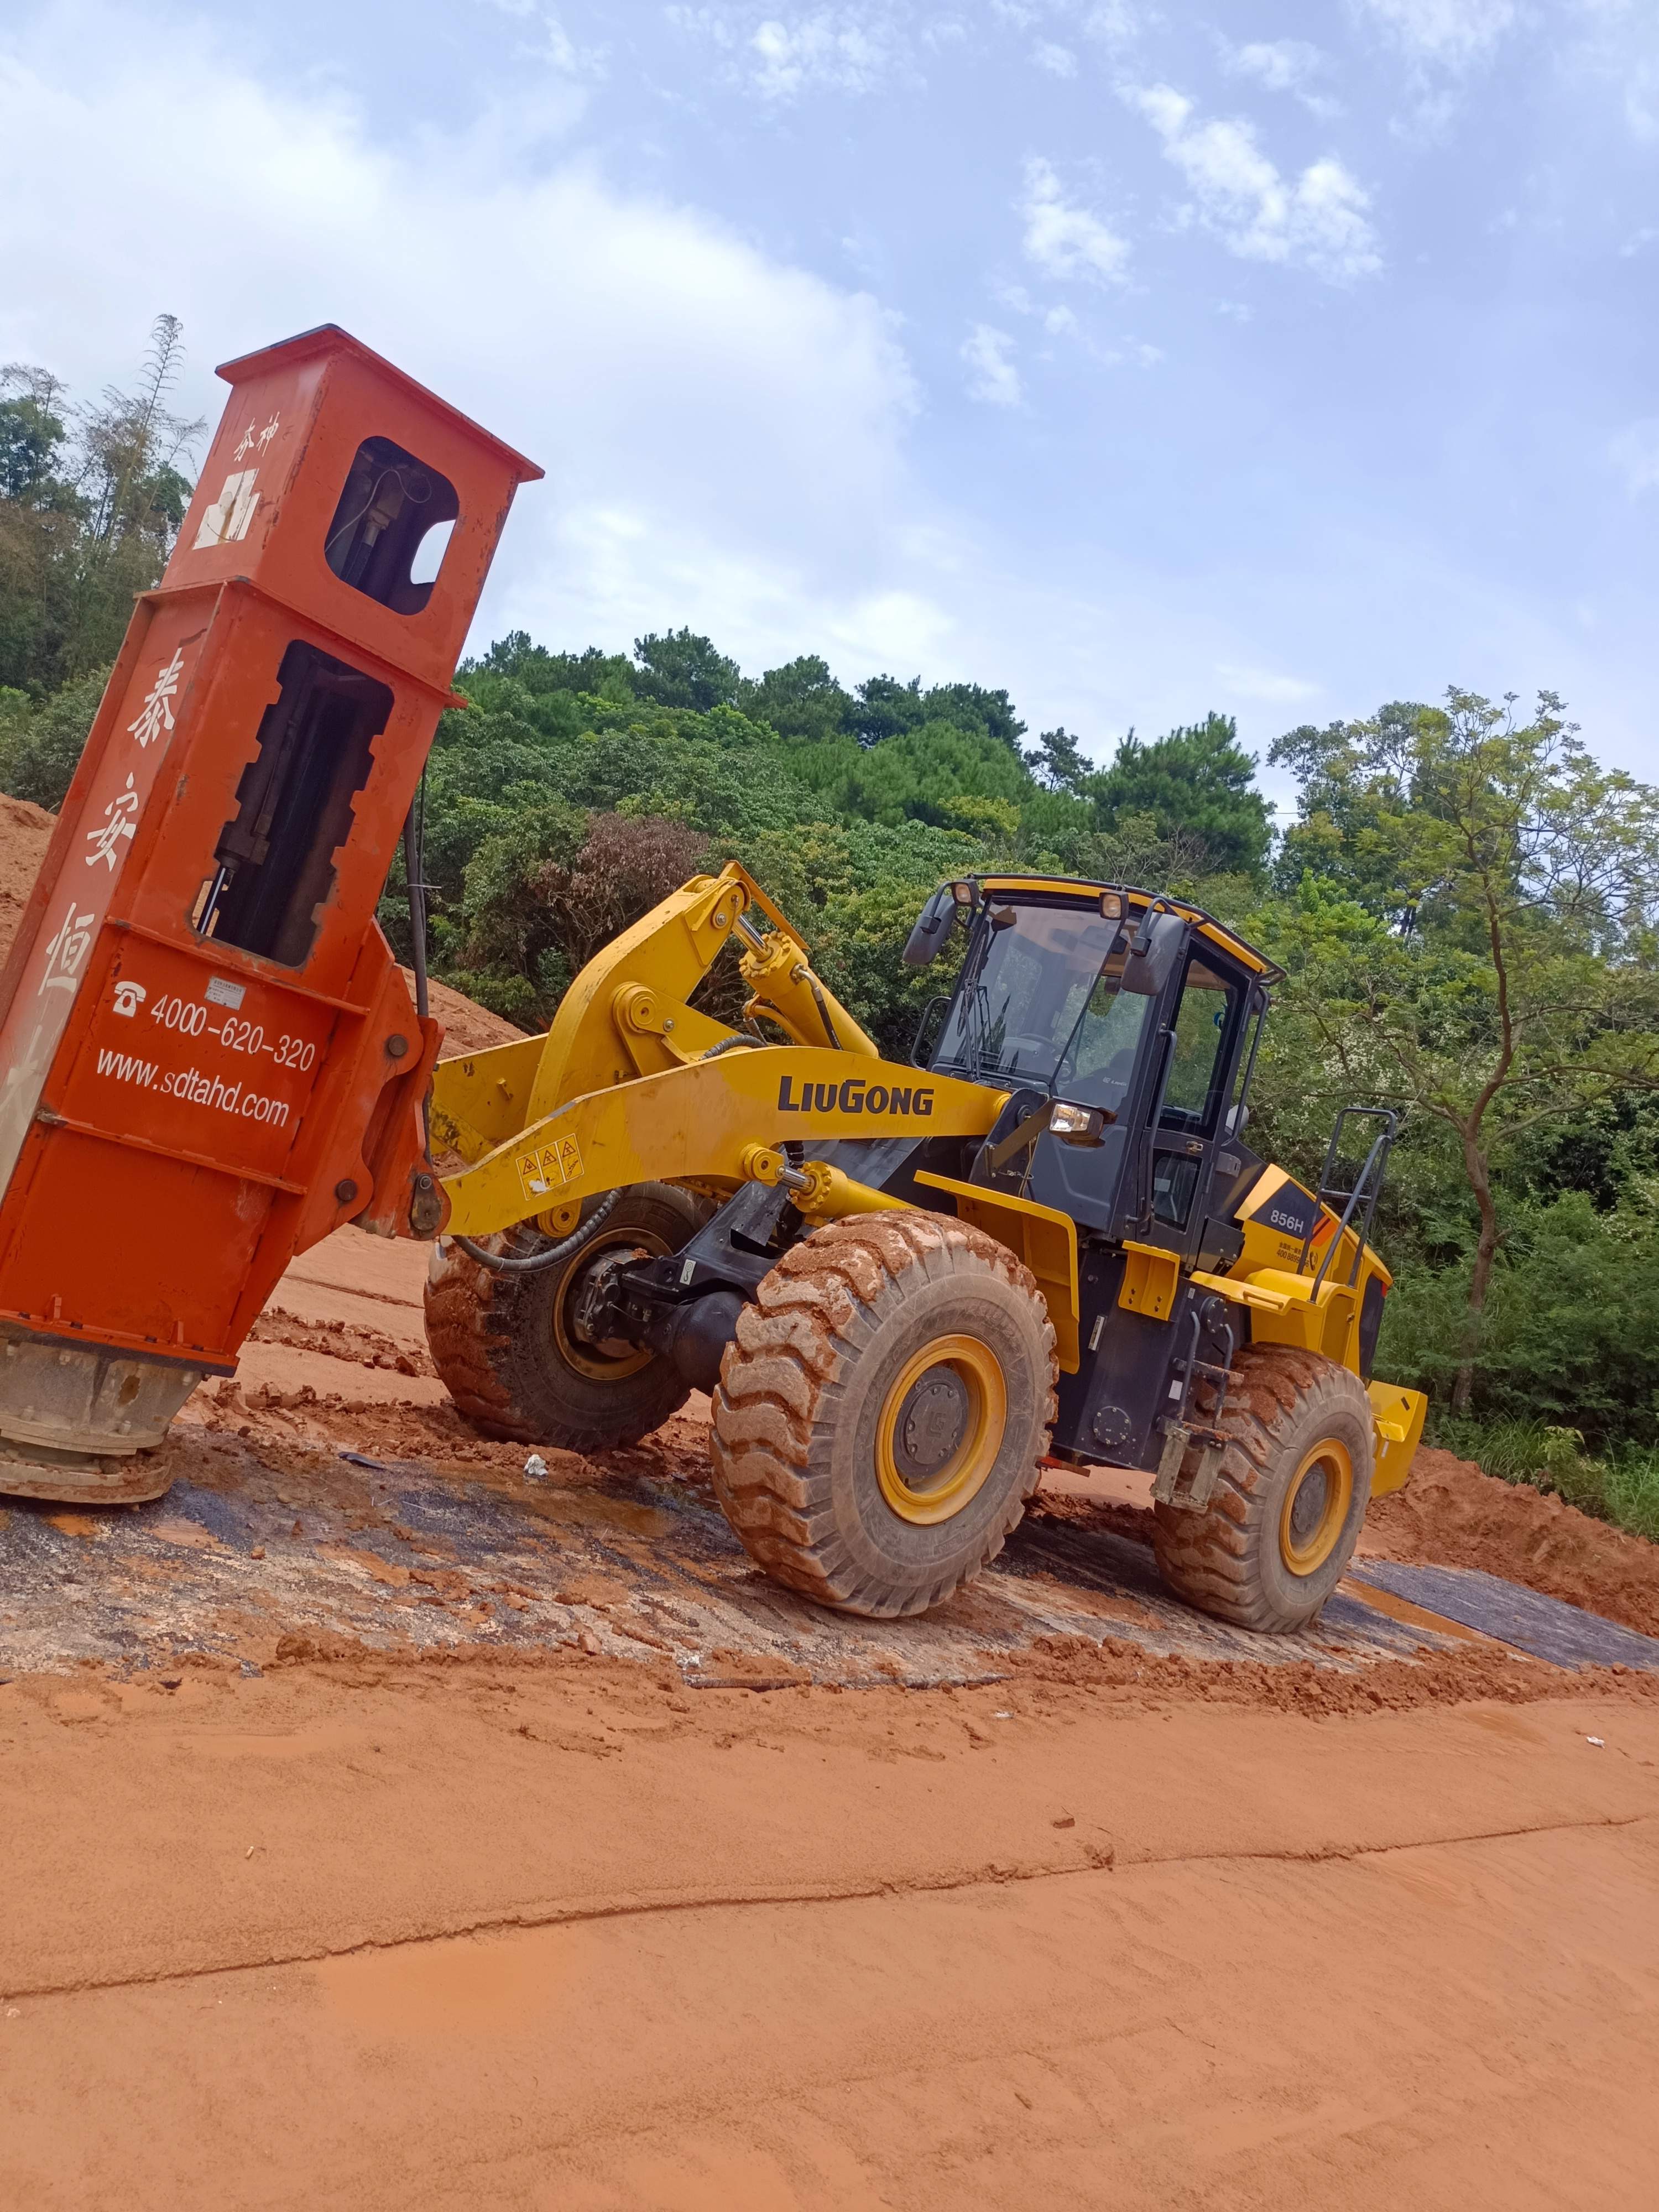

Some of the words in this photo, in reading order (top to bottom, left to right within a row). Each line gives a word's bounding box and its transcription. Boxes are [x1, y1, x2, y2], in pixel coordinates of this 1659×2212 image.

[150, 994, 315, 1071] 4000-620-320
[97, 1048, 290, 1127] www.sdtahd.com
[1270, 1209, 1304, 1234] 856H
